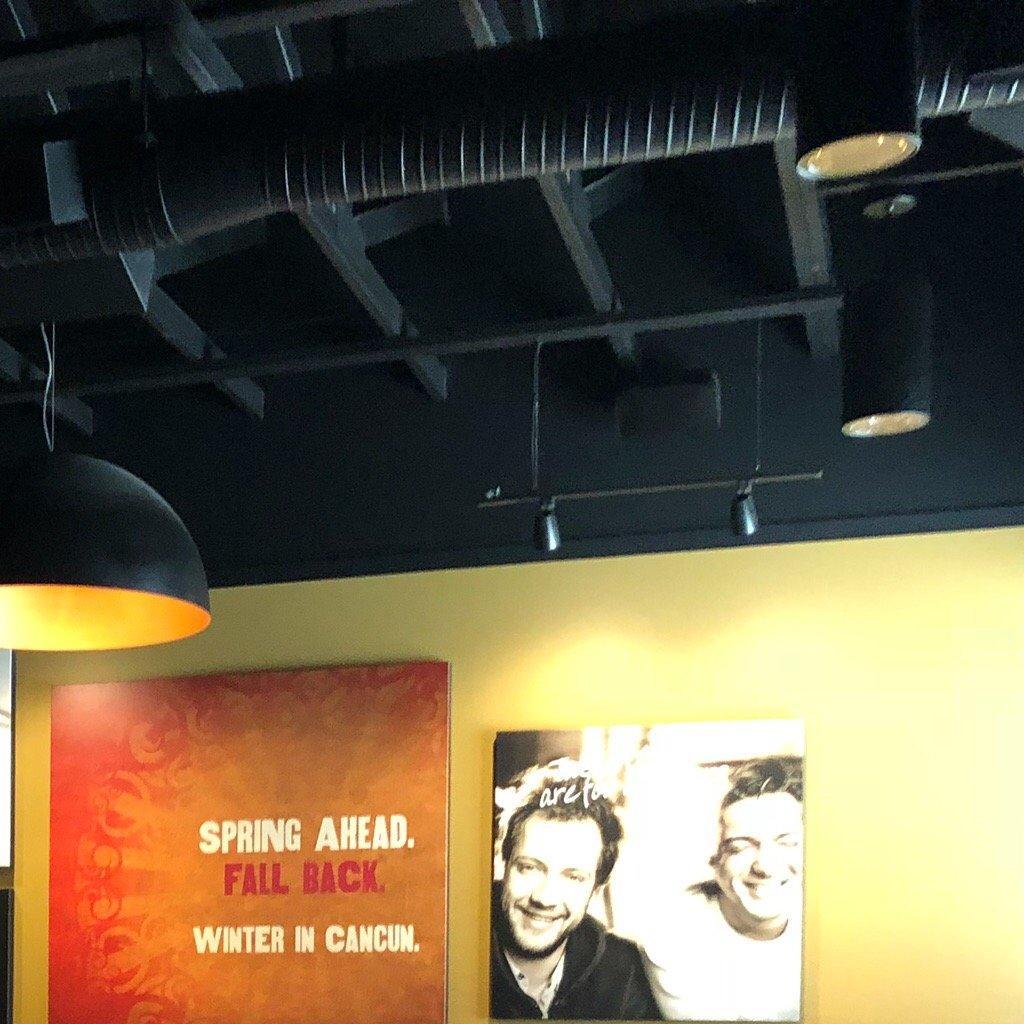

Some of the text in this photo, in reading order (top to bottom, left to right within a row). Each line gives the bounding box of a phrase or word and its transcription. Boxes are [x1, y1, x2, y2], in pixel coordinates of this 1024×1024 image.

[198, 813, 415, 855] SPRING AHEAD.
[224, 859, 385, 896] FALL BACK.
[192, 922, 420, 954] WINTER IN CANCUN.
